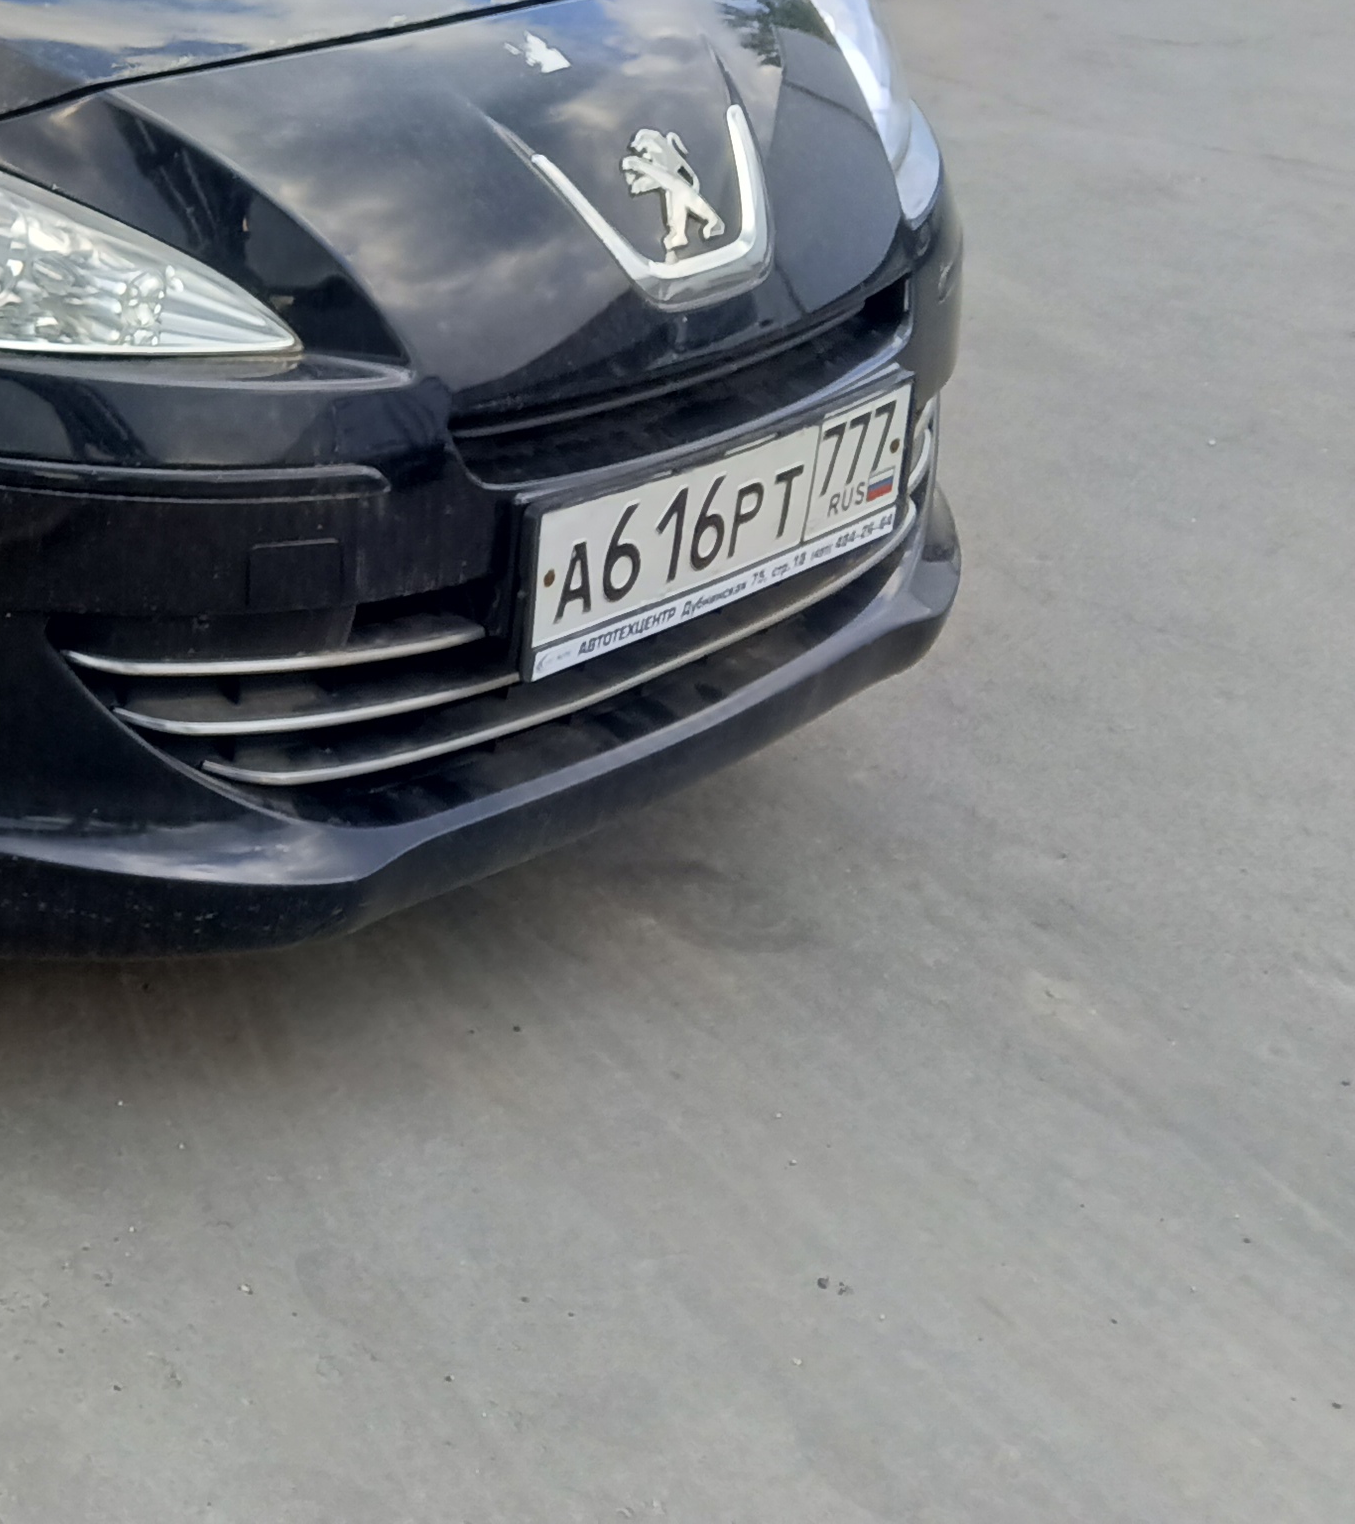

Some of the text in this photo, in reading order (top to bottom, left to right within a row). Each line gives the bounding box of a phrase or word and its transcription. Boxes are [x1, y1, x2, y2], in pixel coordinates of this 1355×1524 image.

[554, 402, 897, 622] А616РТ 777
[827, 481, 865, 517] RUS
[578, 607, 677, 655] АВТОТЕХЦЕНТР
